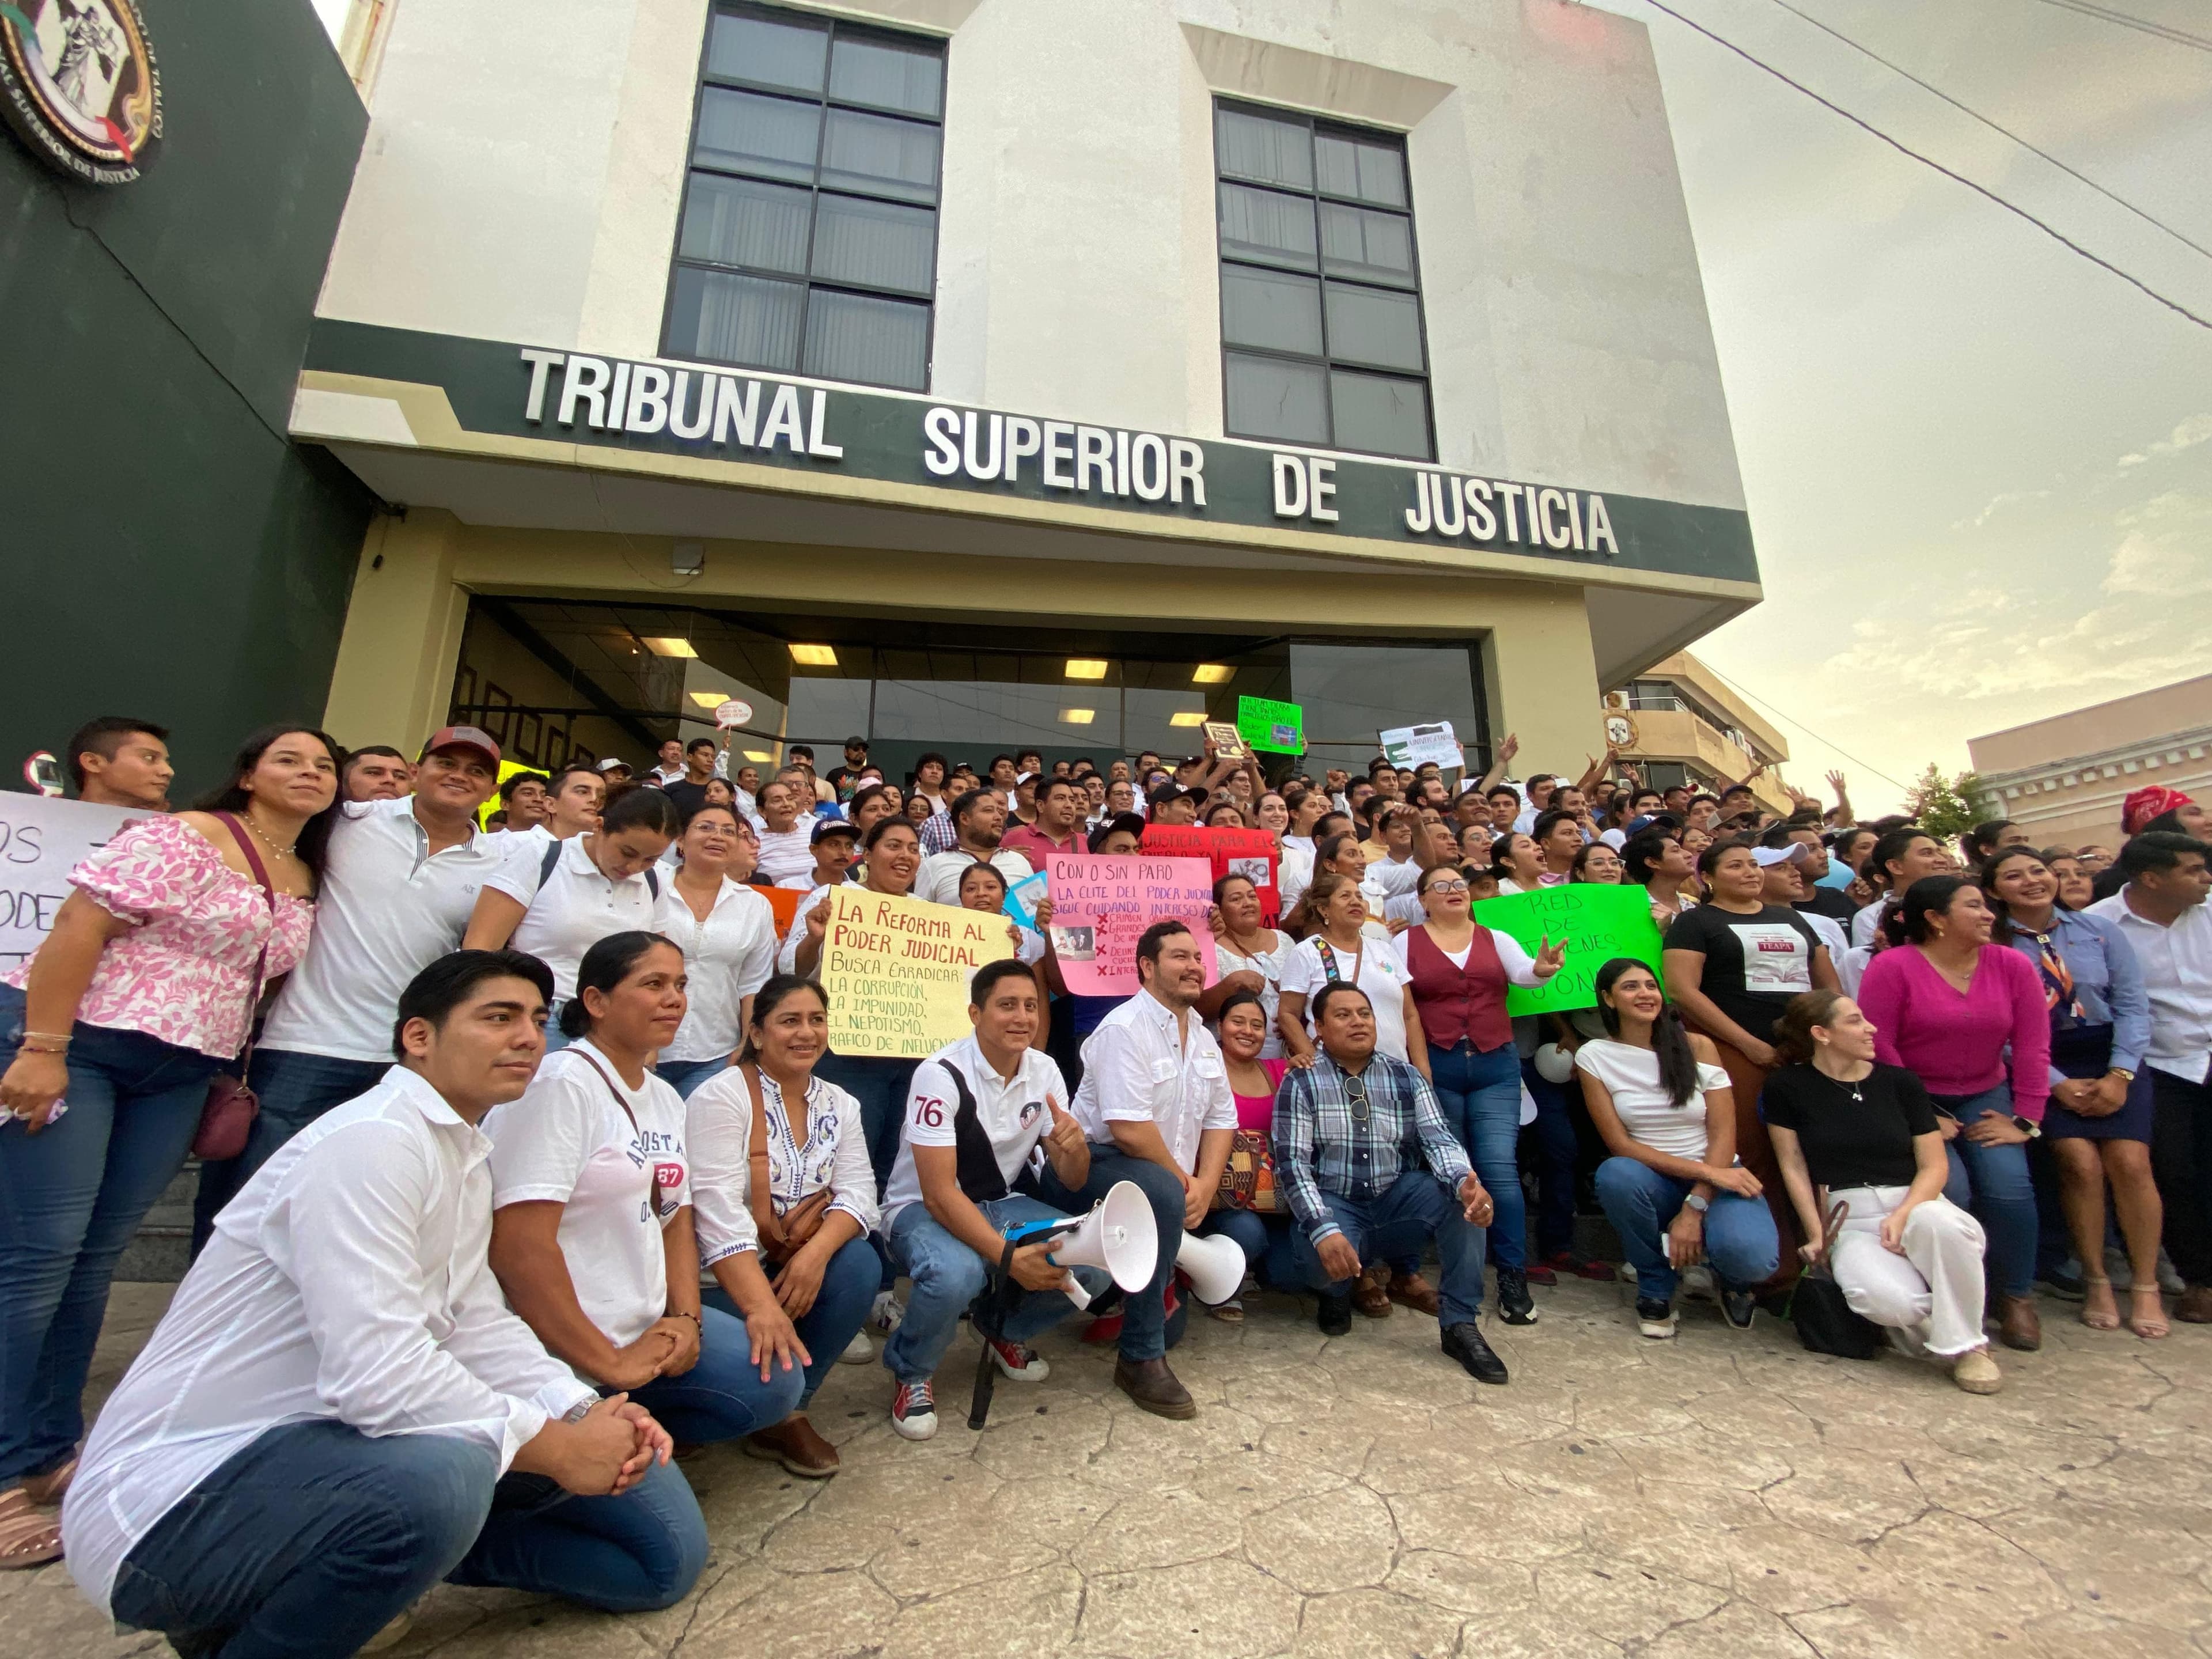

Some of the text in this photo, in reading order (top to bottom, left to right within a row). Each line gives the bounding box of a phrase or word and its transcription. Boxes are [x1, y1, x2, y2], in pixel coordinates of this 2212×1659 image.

[520, 349, 1619, 554] TRIBUNAL SUPERIOR DE JUSTICIA
[1210, 834, 1245, 847] PARA
[1253, 835, 1268, 849] EL
[1056, 860, 1173, 881] CON O SIN PARO
[1058, 887, 1074, 900] LA
[1116, 885, 1138, 899] DEL
[1147, 885, 1181, 900] PODER
[1085, 900, 1140, 916] CUIDANDO
[1151, 903, 1198, 917] INTERESES
[1523, 893, 1583, 915] RED
[838, 895, 986, 941] LA REFORMA AL
[1108, 922, 1146, 934] GRANDES
[1109, 913, 1142, 923] CRIMEN
[1543, 916, 1581, 935] DE
[834, 924, 980, 967] PODER JUDICIAL
[1113, 934, 1125, 943] DE
[1760, 942, 1791, 950] TEAPA
[830, 950, 963, 983] BUSCA ERRADICAR:
[830, 976, 928, 1001] LA CORRUPCIÓN,
[827, 995, 927, 1019] LA IMPUNIDAD,
[849, 1014, 925, 1037] NEPOTISMO,
[830, 1032, 871, 1048] RAFICO
[876, 1036, 893, 1051] DE
[914, 1094, 944, 1128] 76
